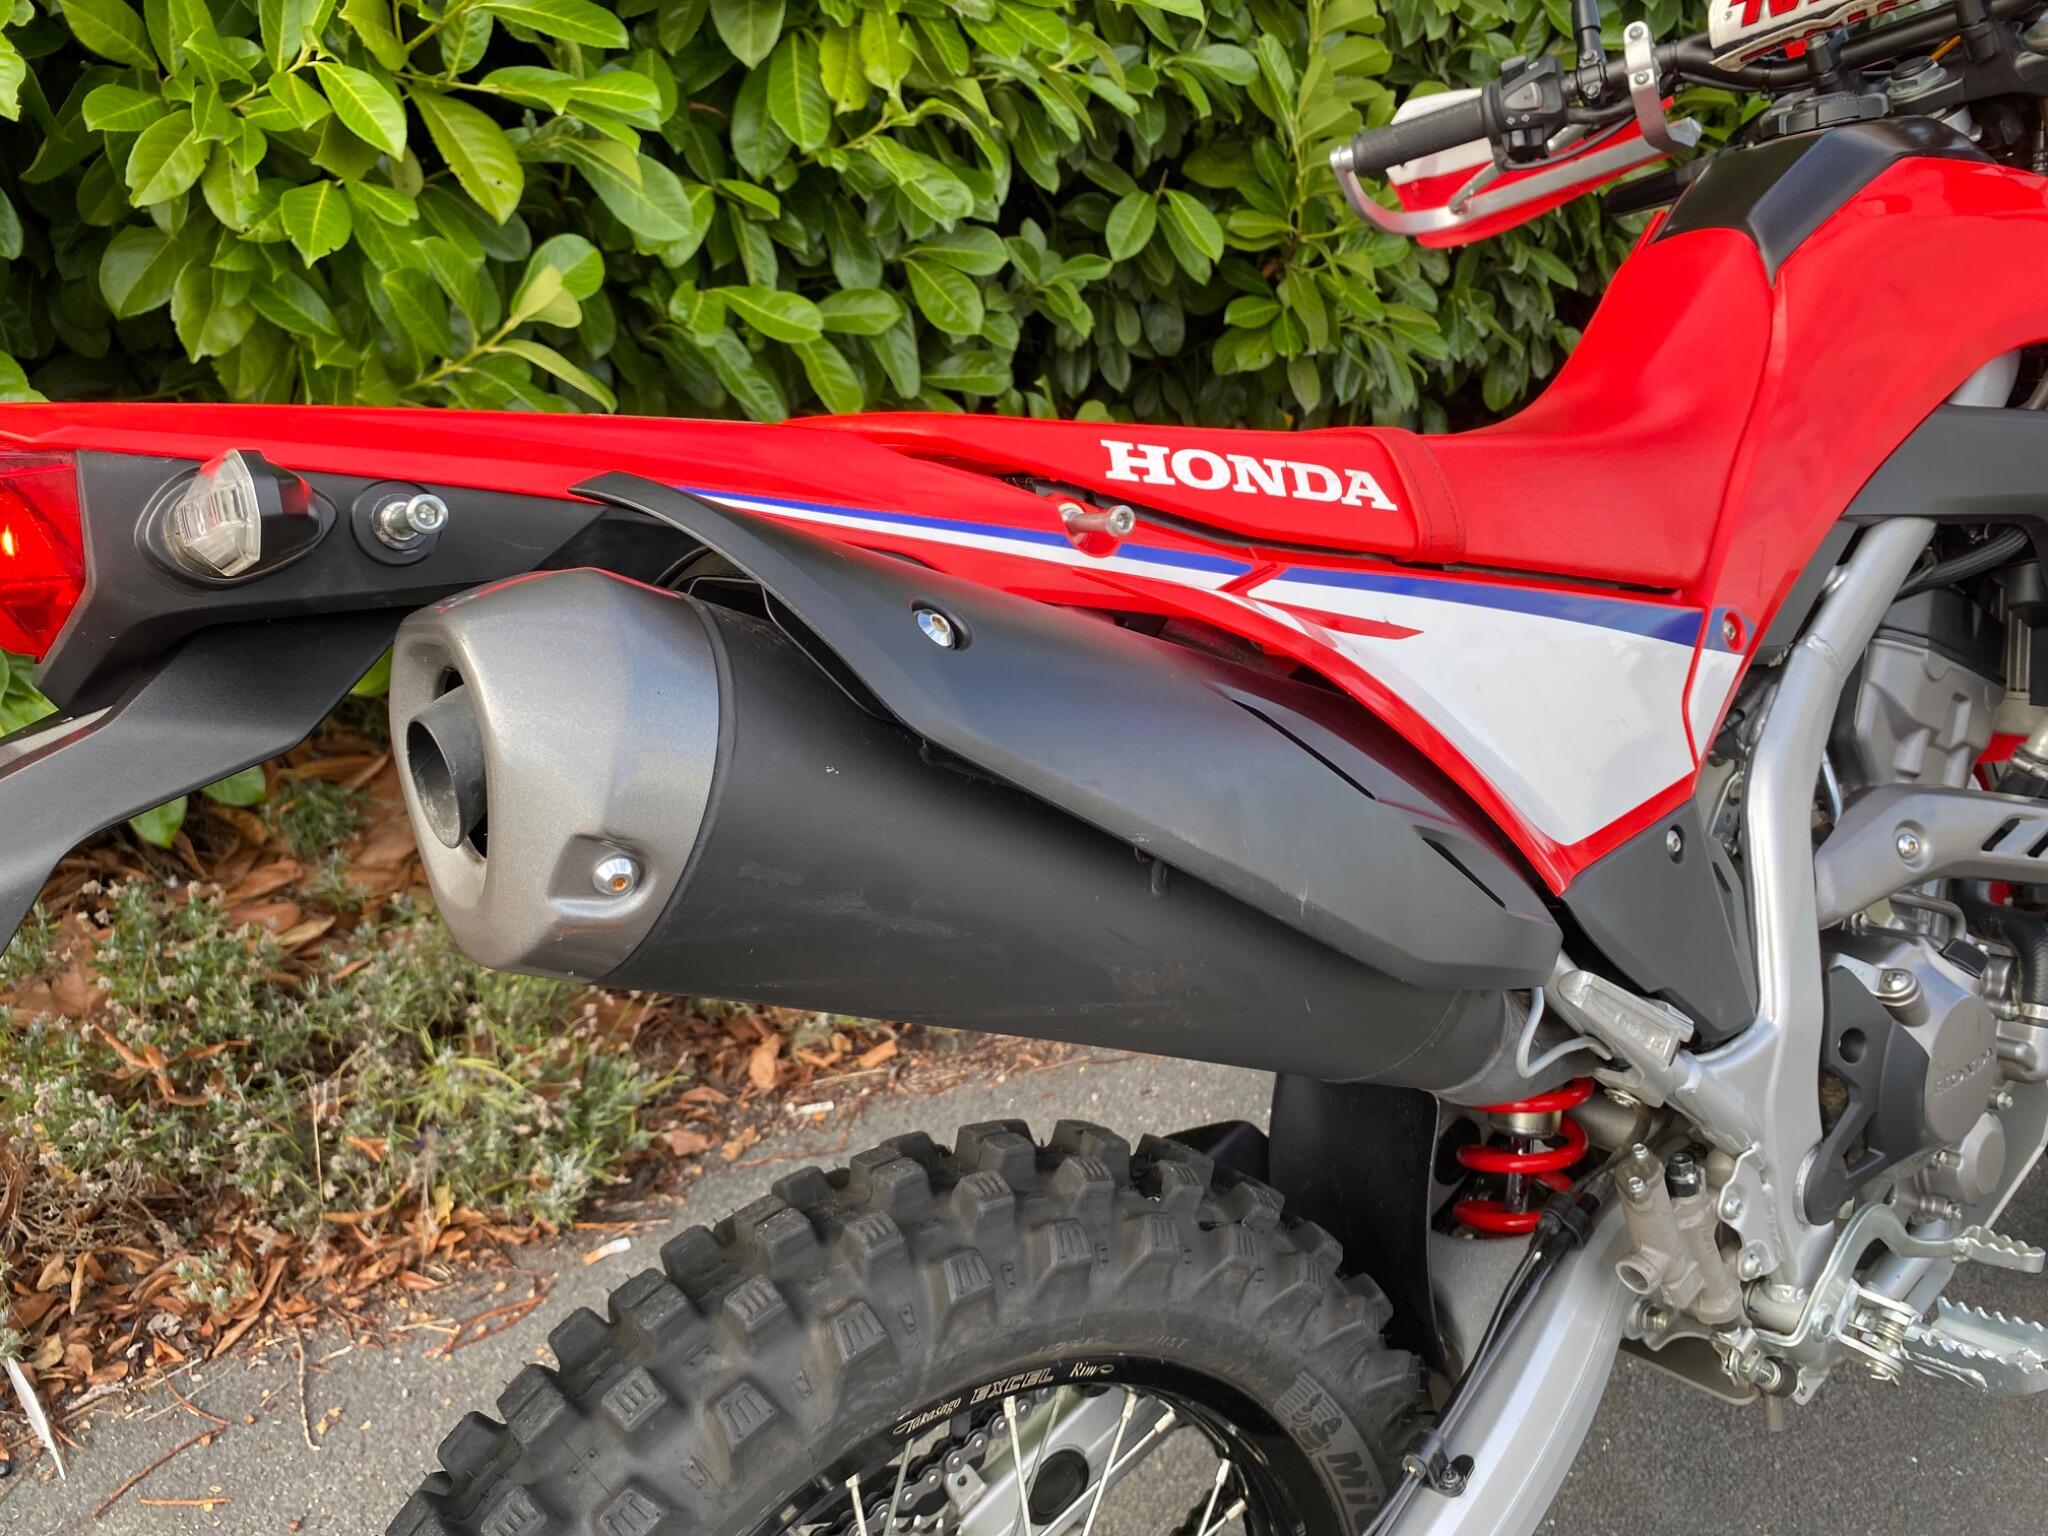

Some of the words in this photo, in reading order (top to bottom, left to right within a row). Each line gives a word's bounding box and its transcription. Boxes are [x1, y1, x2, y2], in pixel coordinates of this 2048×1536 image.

[1100, 439, 1399, 512] HONDA
[893, 1397, 962, 1435] Takasago
[970, 1368, 1055, 1405] EXCEL
[1070, 1361, 1115, 1380] Rim
